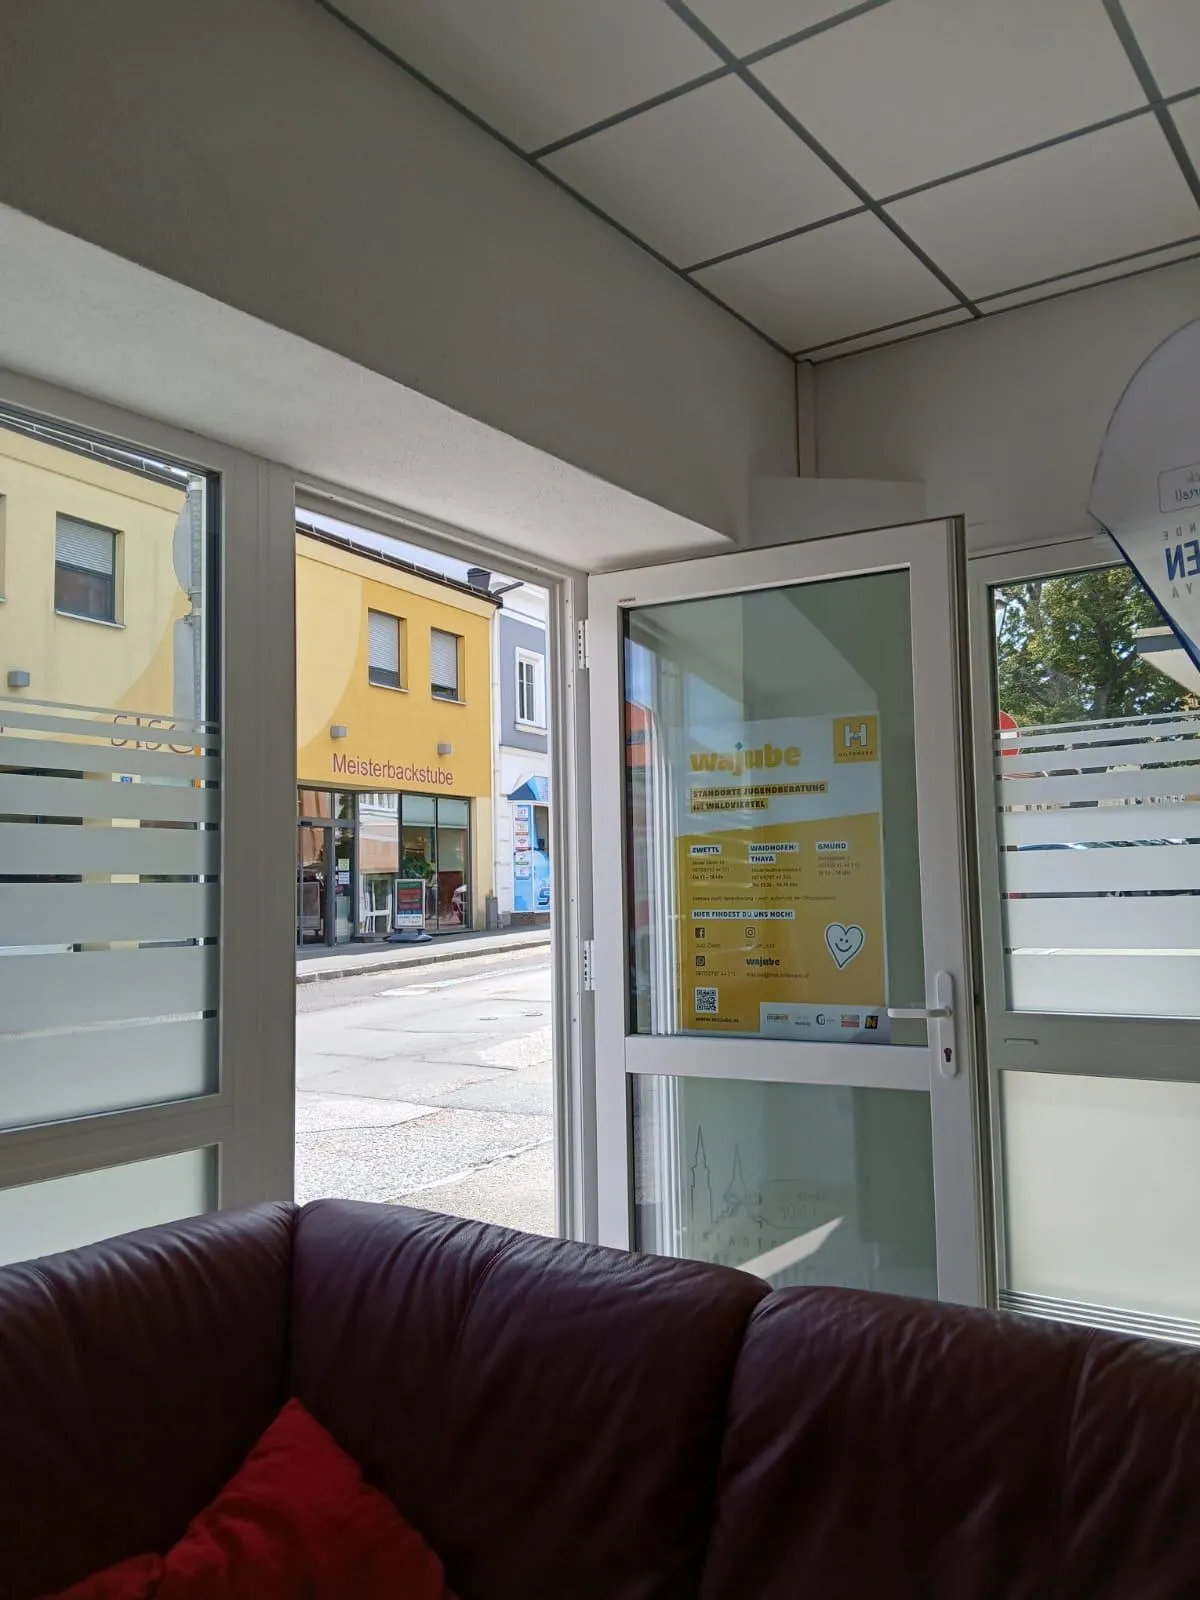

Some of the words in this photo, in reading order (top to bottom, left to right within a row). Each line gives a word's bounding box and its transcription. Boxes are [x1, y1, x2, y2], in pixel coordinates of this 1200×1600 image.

[689, 742, 801, 776] wajube
[333, 753, 453, 785] Meisterbackstube
[693, 788, 741, 798] STANDORTE
[744, 783, 826, 795] JUGENDBERATUNG
[706, 800, 765, 810] WALDVIERTEL
[692, 846, 720, 854] ZWETTL
[818, 841, 847, 850] GMÜND
[750, 855, 774, 863] THAYA
[745, 956, 780, 968] wajube
